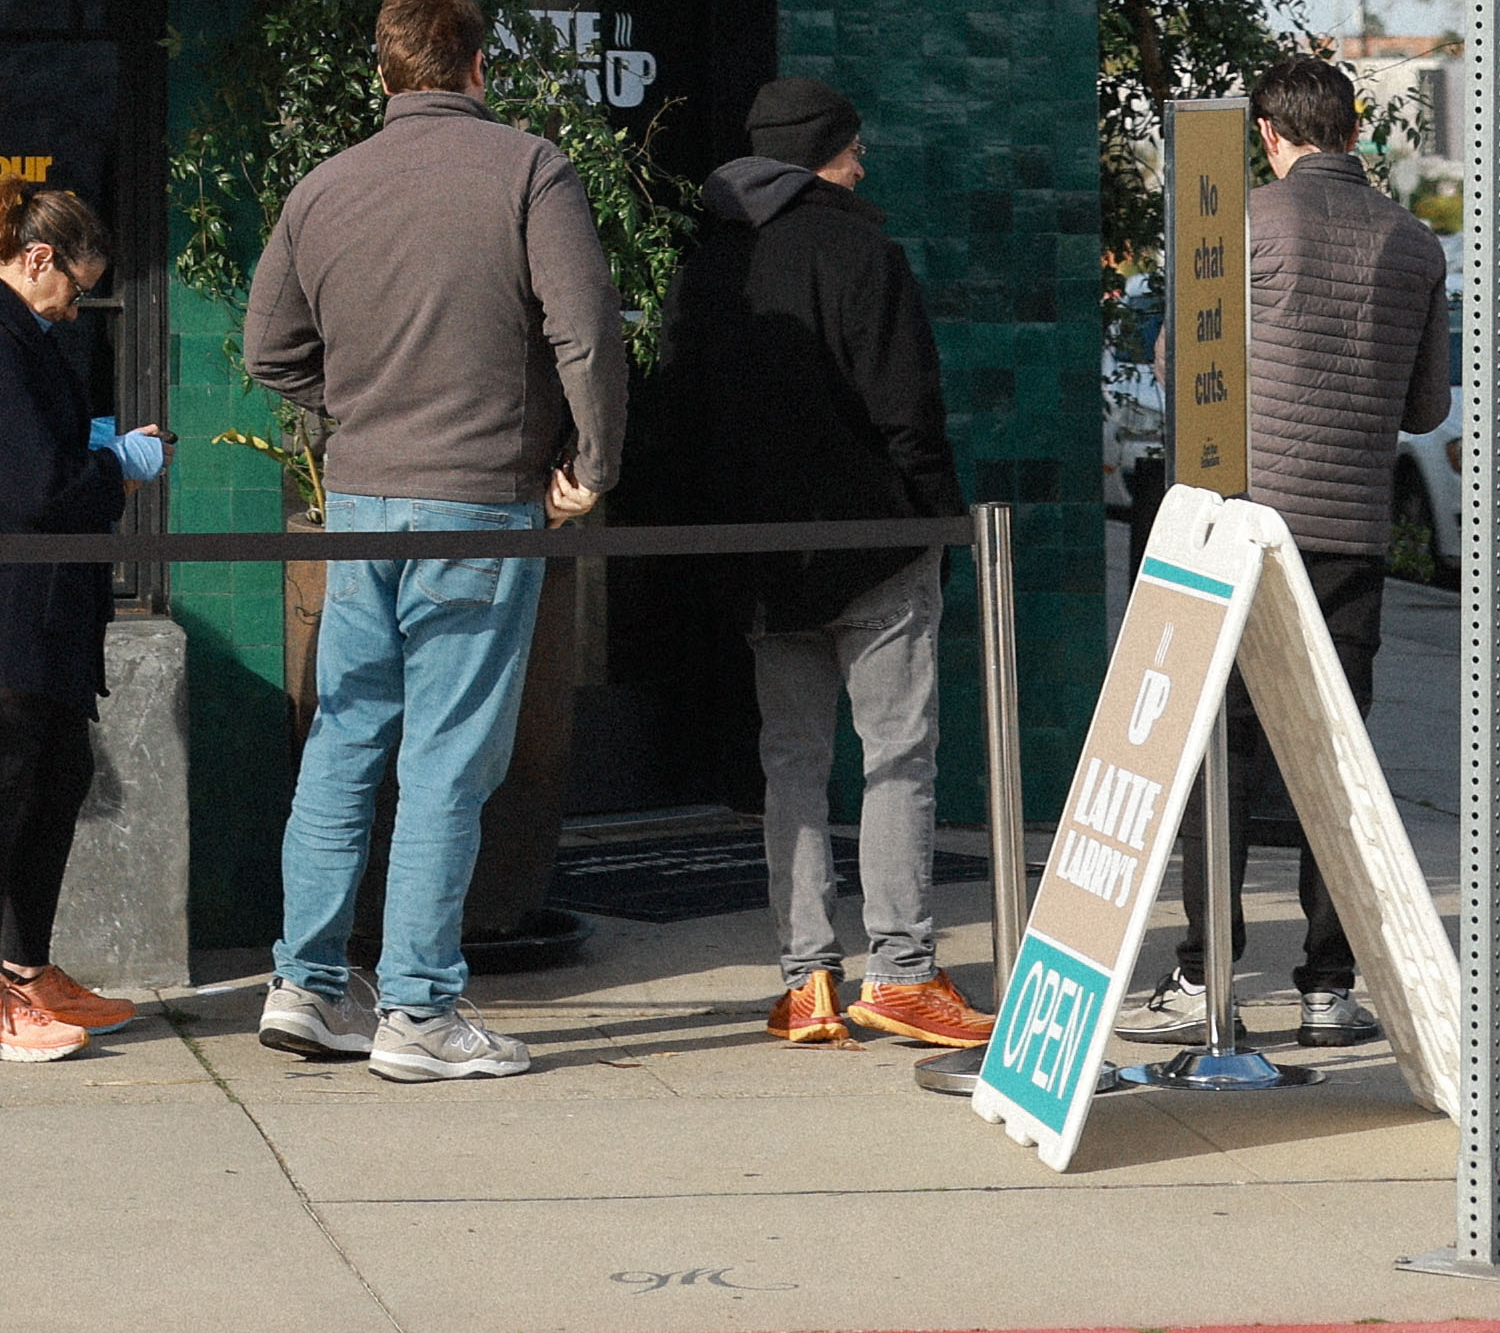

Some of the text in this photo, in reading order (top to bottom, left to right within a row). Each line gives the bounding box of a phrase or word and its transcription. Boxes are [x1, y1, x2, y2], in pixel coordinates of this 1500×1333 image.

[606, 50, 656, 107] UP
[1200, 175, 1218, 217] No
[1194, 237, 1225, 279] chat
[1197, 298, 1222, 343] and
[1195, 362, 1228, 405] cuts.
[1129, 669, 1171, 745] UP
[1074, 757, 1162, 851] LATTE
[1056, 830, 1139, 909] LARRY'S
[1003, 960, 1095, 1099] OPEN
